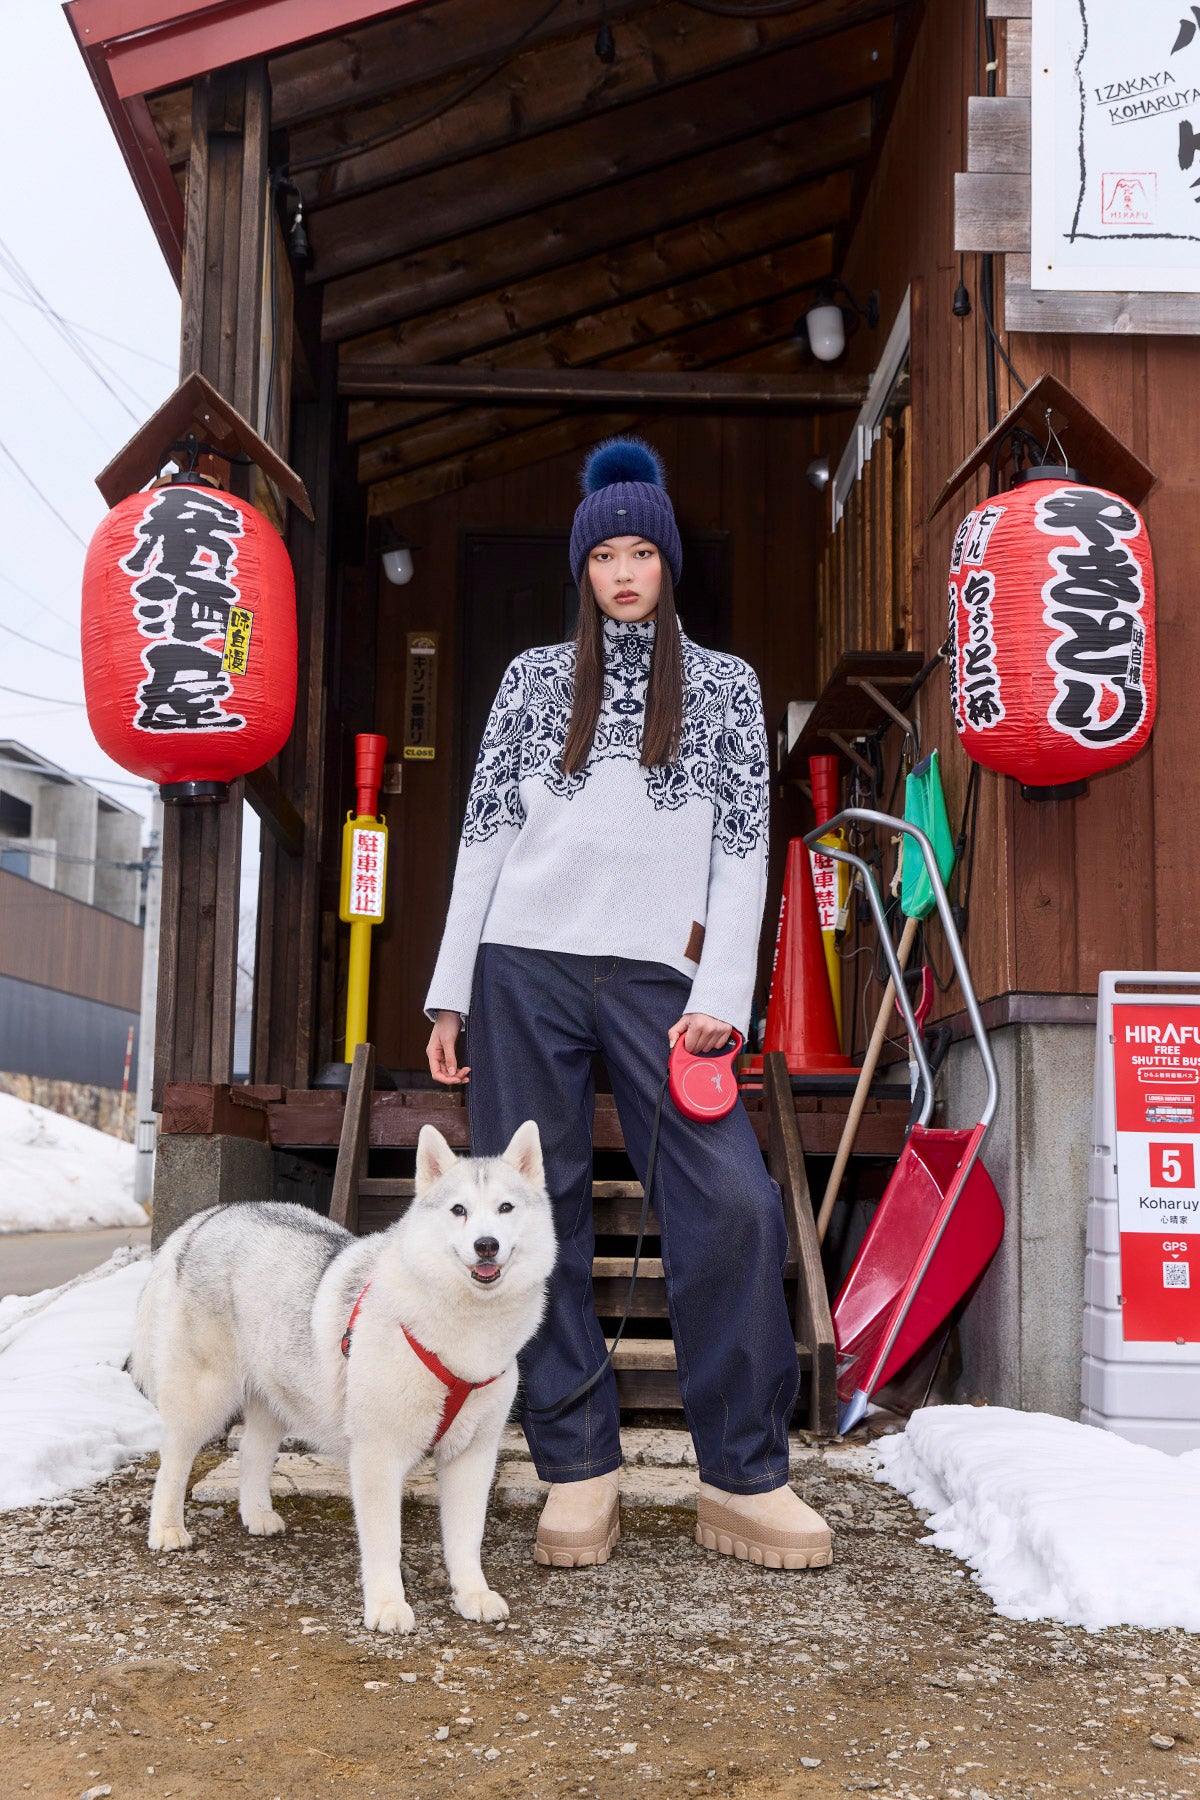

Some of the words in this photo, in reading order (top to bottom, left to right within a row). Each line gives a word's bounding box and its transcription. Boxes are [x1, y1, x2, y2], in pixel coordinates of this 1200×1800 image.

[1094, 71, 1175, 101] IZAKAYA
[1109, 88, 1200, 122] KOHARUYA
[966, 510, 997, 559] ビール
[120, 488, 245, 732] 居酒屋
[1041, 490, 1145, 743] やきとり
[224, 610, 250, 673] 味自慢
[964, 574, 1001, 727] ちょっと一杯
[355, 834, 379, 913] 駐車禁止
[1131, 1056, 1180, 1066] SHUTTLE
[1154, 1045, 1181, 1055] FREE
[1161, 1149, 1182, 1183] 5
[1160, 1215, 1188, 1224] 心晴家
[1162, 1241, 1188, 1252] GPS
